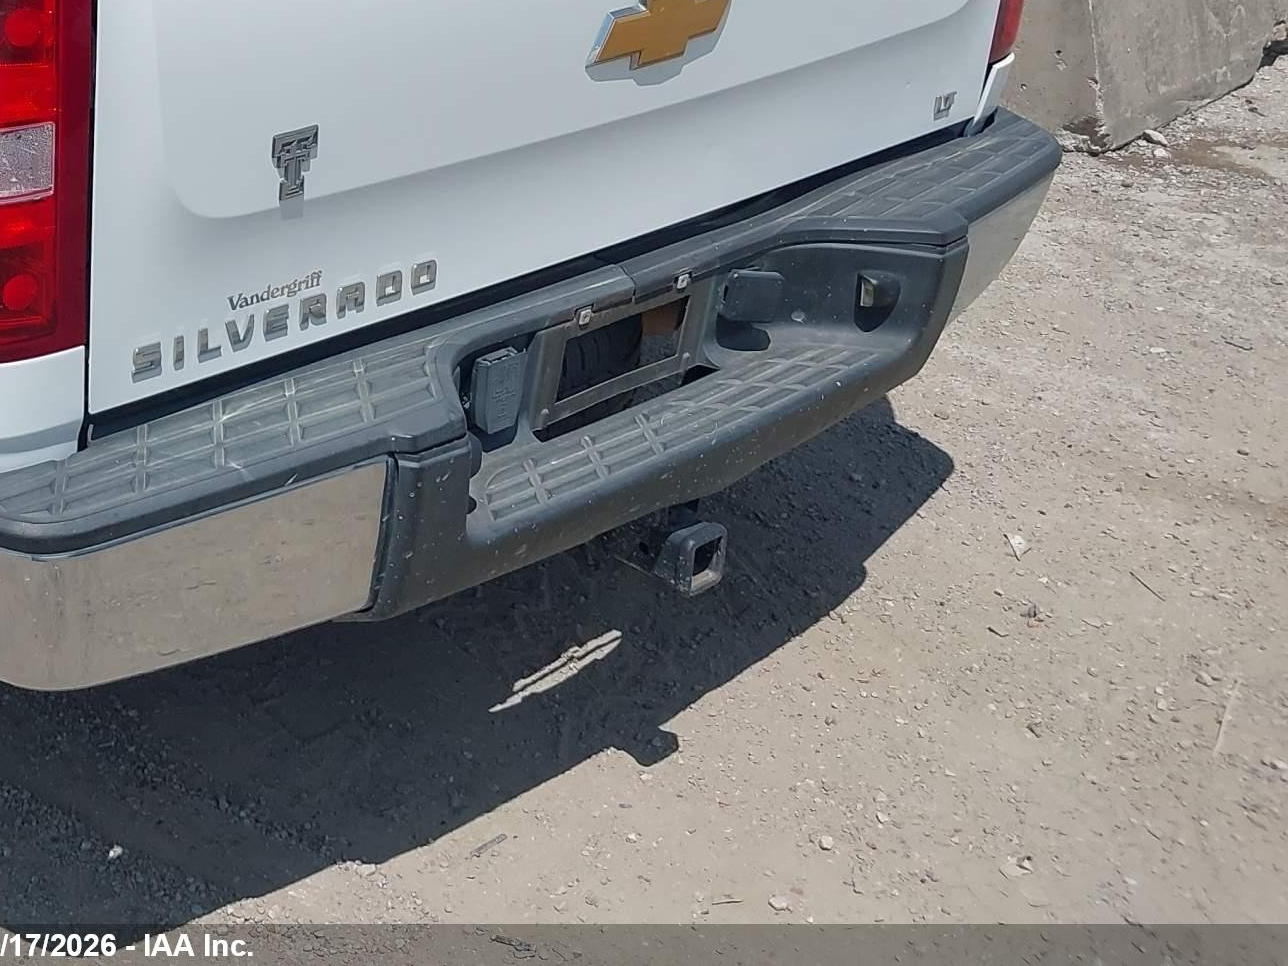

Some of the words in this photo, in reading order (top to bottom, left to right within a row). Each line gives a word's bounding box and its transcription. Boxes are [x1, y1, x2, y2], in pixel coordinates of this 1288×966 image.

[933, 91, 957, 122] LT
[225, 269, 323, 312] Vandergriff
[131, 259, 438, 383] SILVERADO
